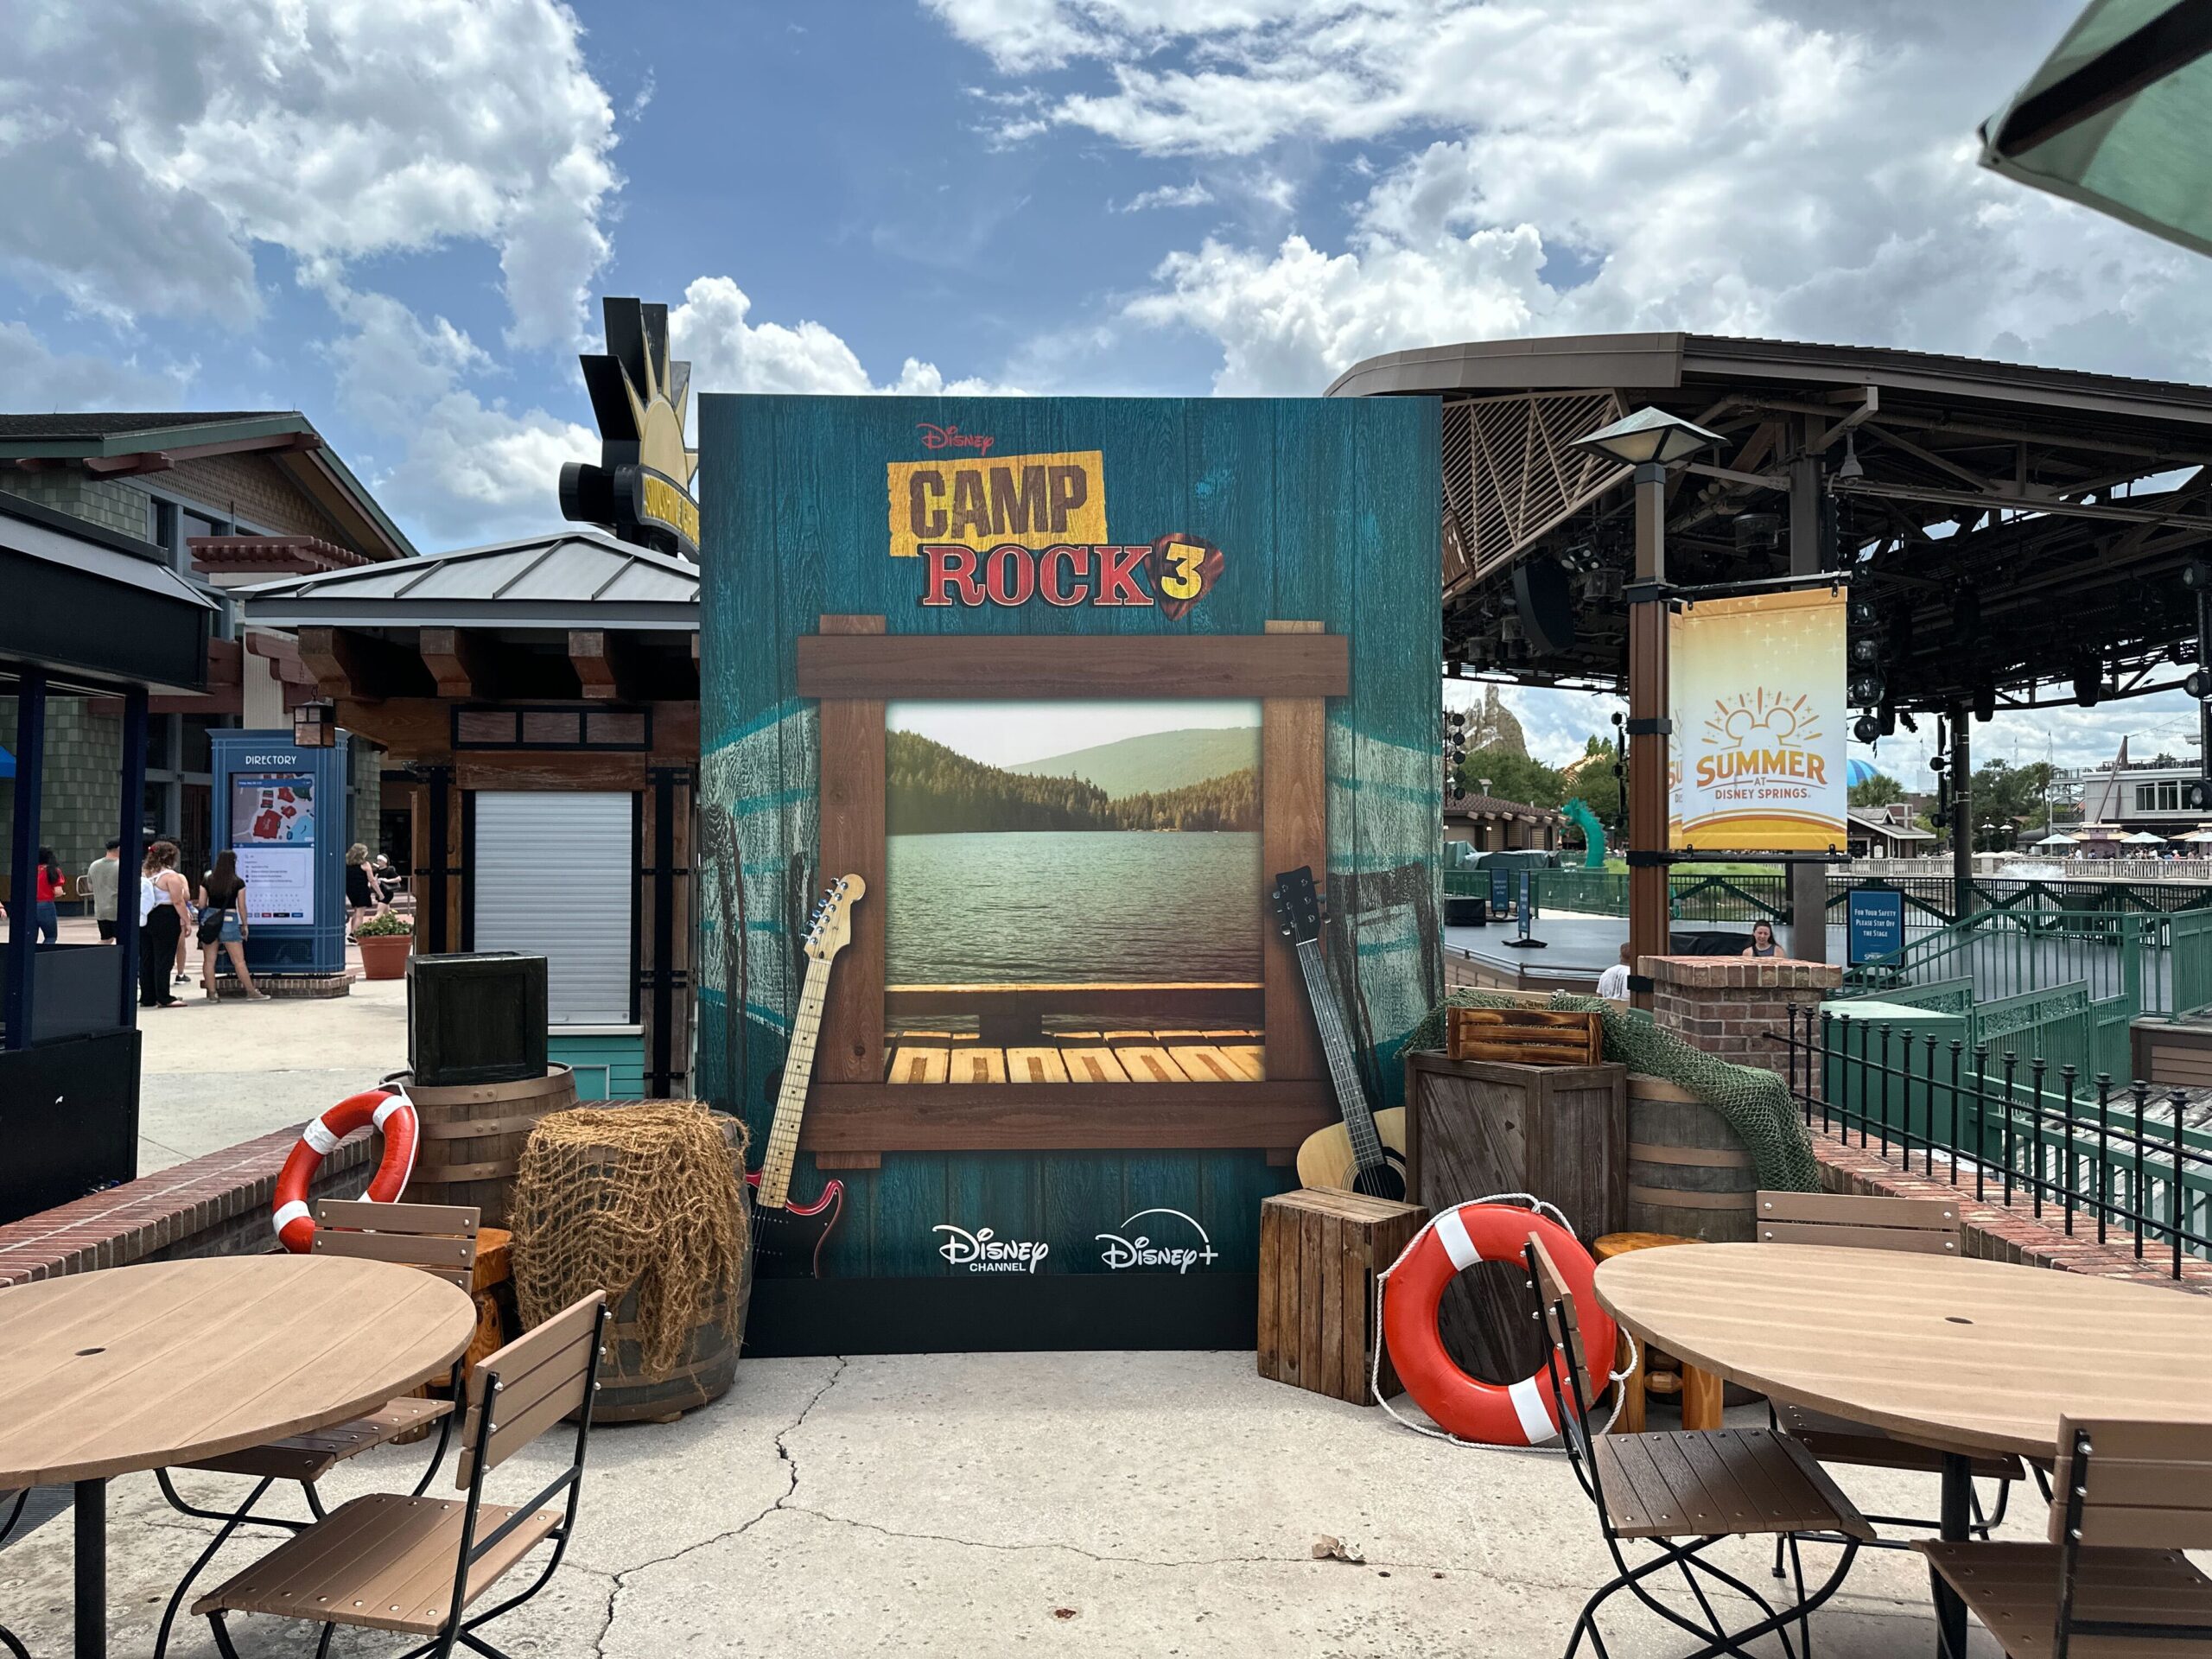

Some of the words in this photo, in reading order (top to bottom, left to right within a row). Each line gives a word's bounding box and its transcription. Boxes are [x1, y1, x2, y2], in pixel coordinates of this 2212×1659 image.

[916, 423, 995, 455] Disney
[909, 464, 1088, 539] CAMP
[920, 543, 1154, 607] ROCK
[1159, 542, 1206, 601] 3
[245, 755, 297, 766] DIRECTORY
[1696, 749, 1828, 788] SUMMER
[1754, 777, 1766, 786] AT
[1715, 788, 1754, 800] DISNEY
[1758, 787, 1808, 799] SPRINGS
[1874, 918, 1885, 927] STAY
[1873, 929, 1888, 938] STAGE
[931, 1224, 1049, 1274] Disney
[969, 1262, 1027, 1273] CHANNEL
